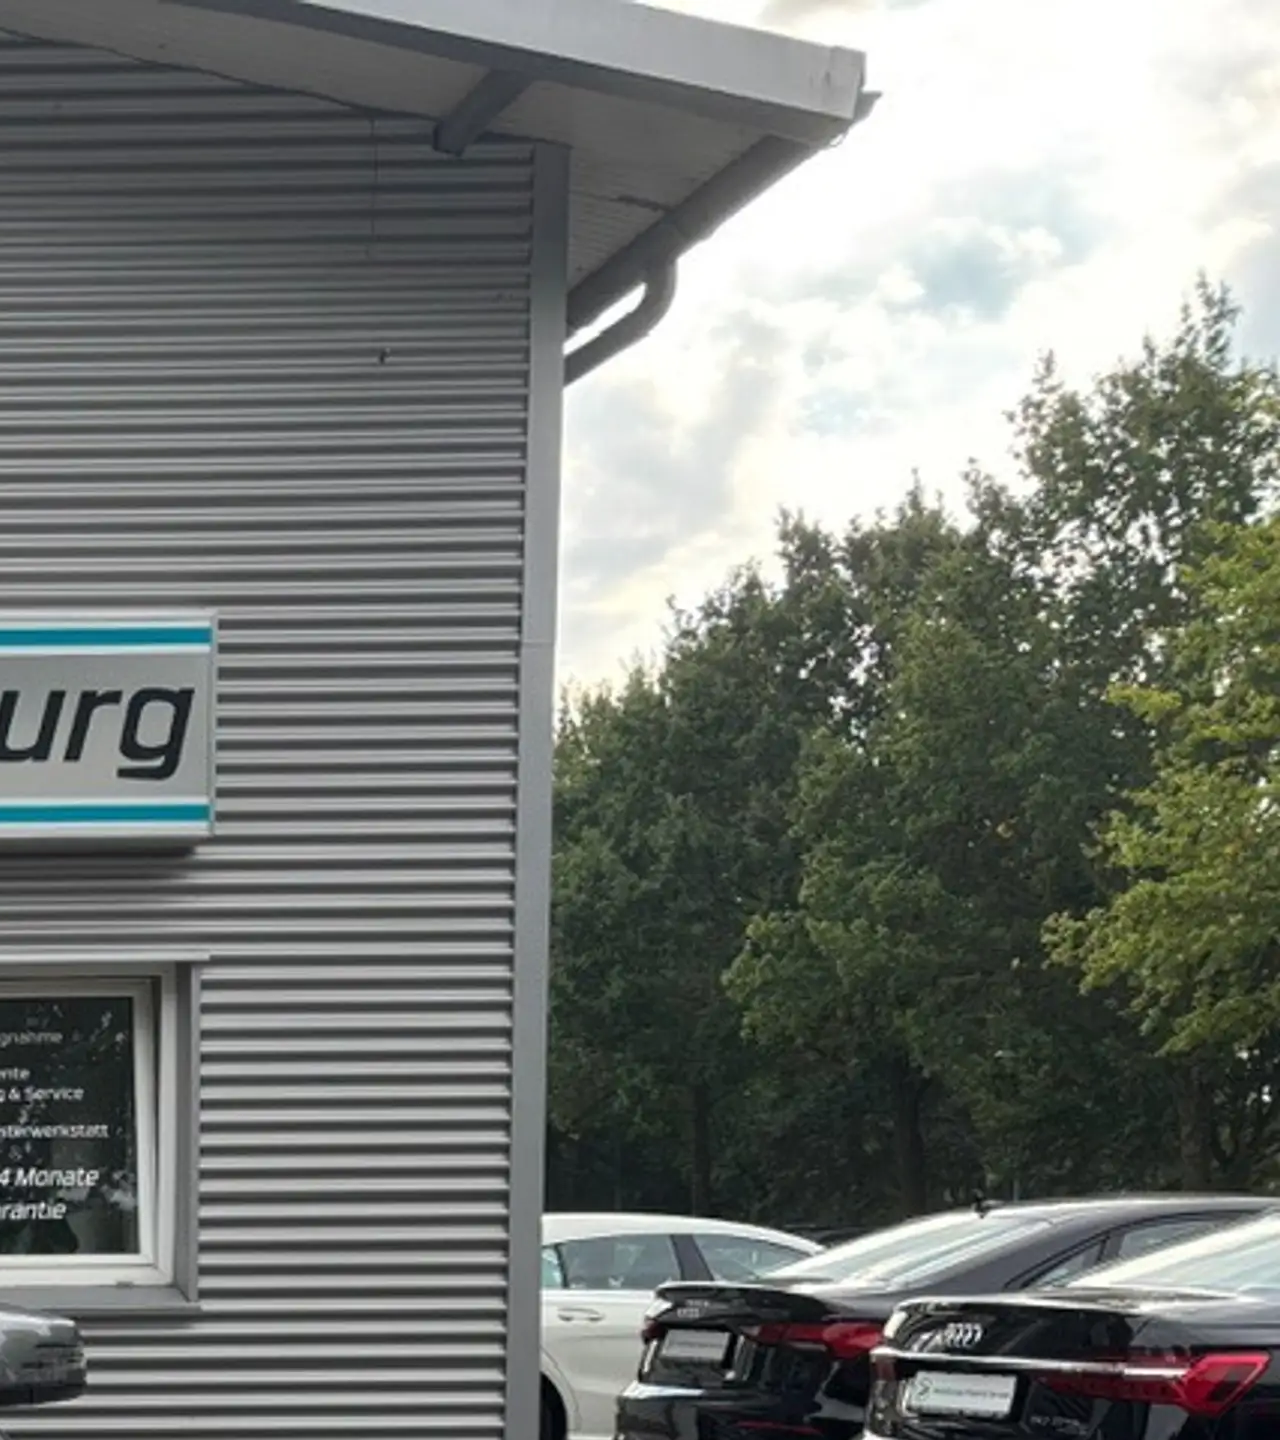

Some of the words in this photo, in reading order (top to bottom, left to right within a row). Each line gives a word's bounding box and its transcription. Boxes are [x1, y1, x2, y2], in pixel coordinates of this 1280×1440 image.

[8, 1088, 21, 1100] &
[24, 1087, 85, 1101] Service
[14, 1167, 100, 1187] Monate
